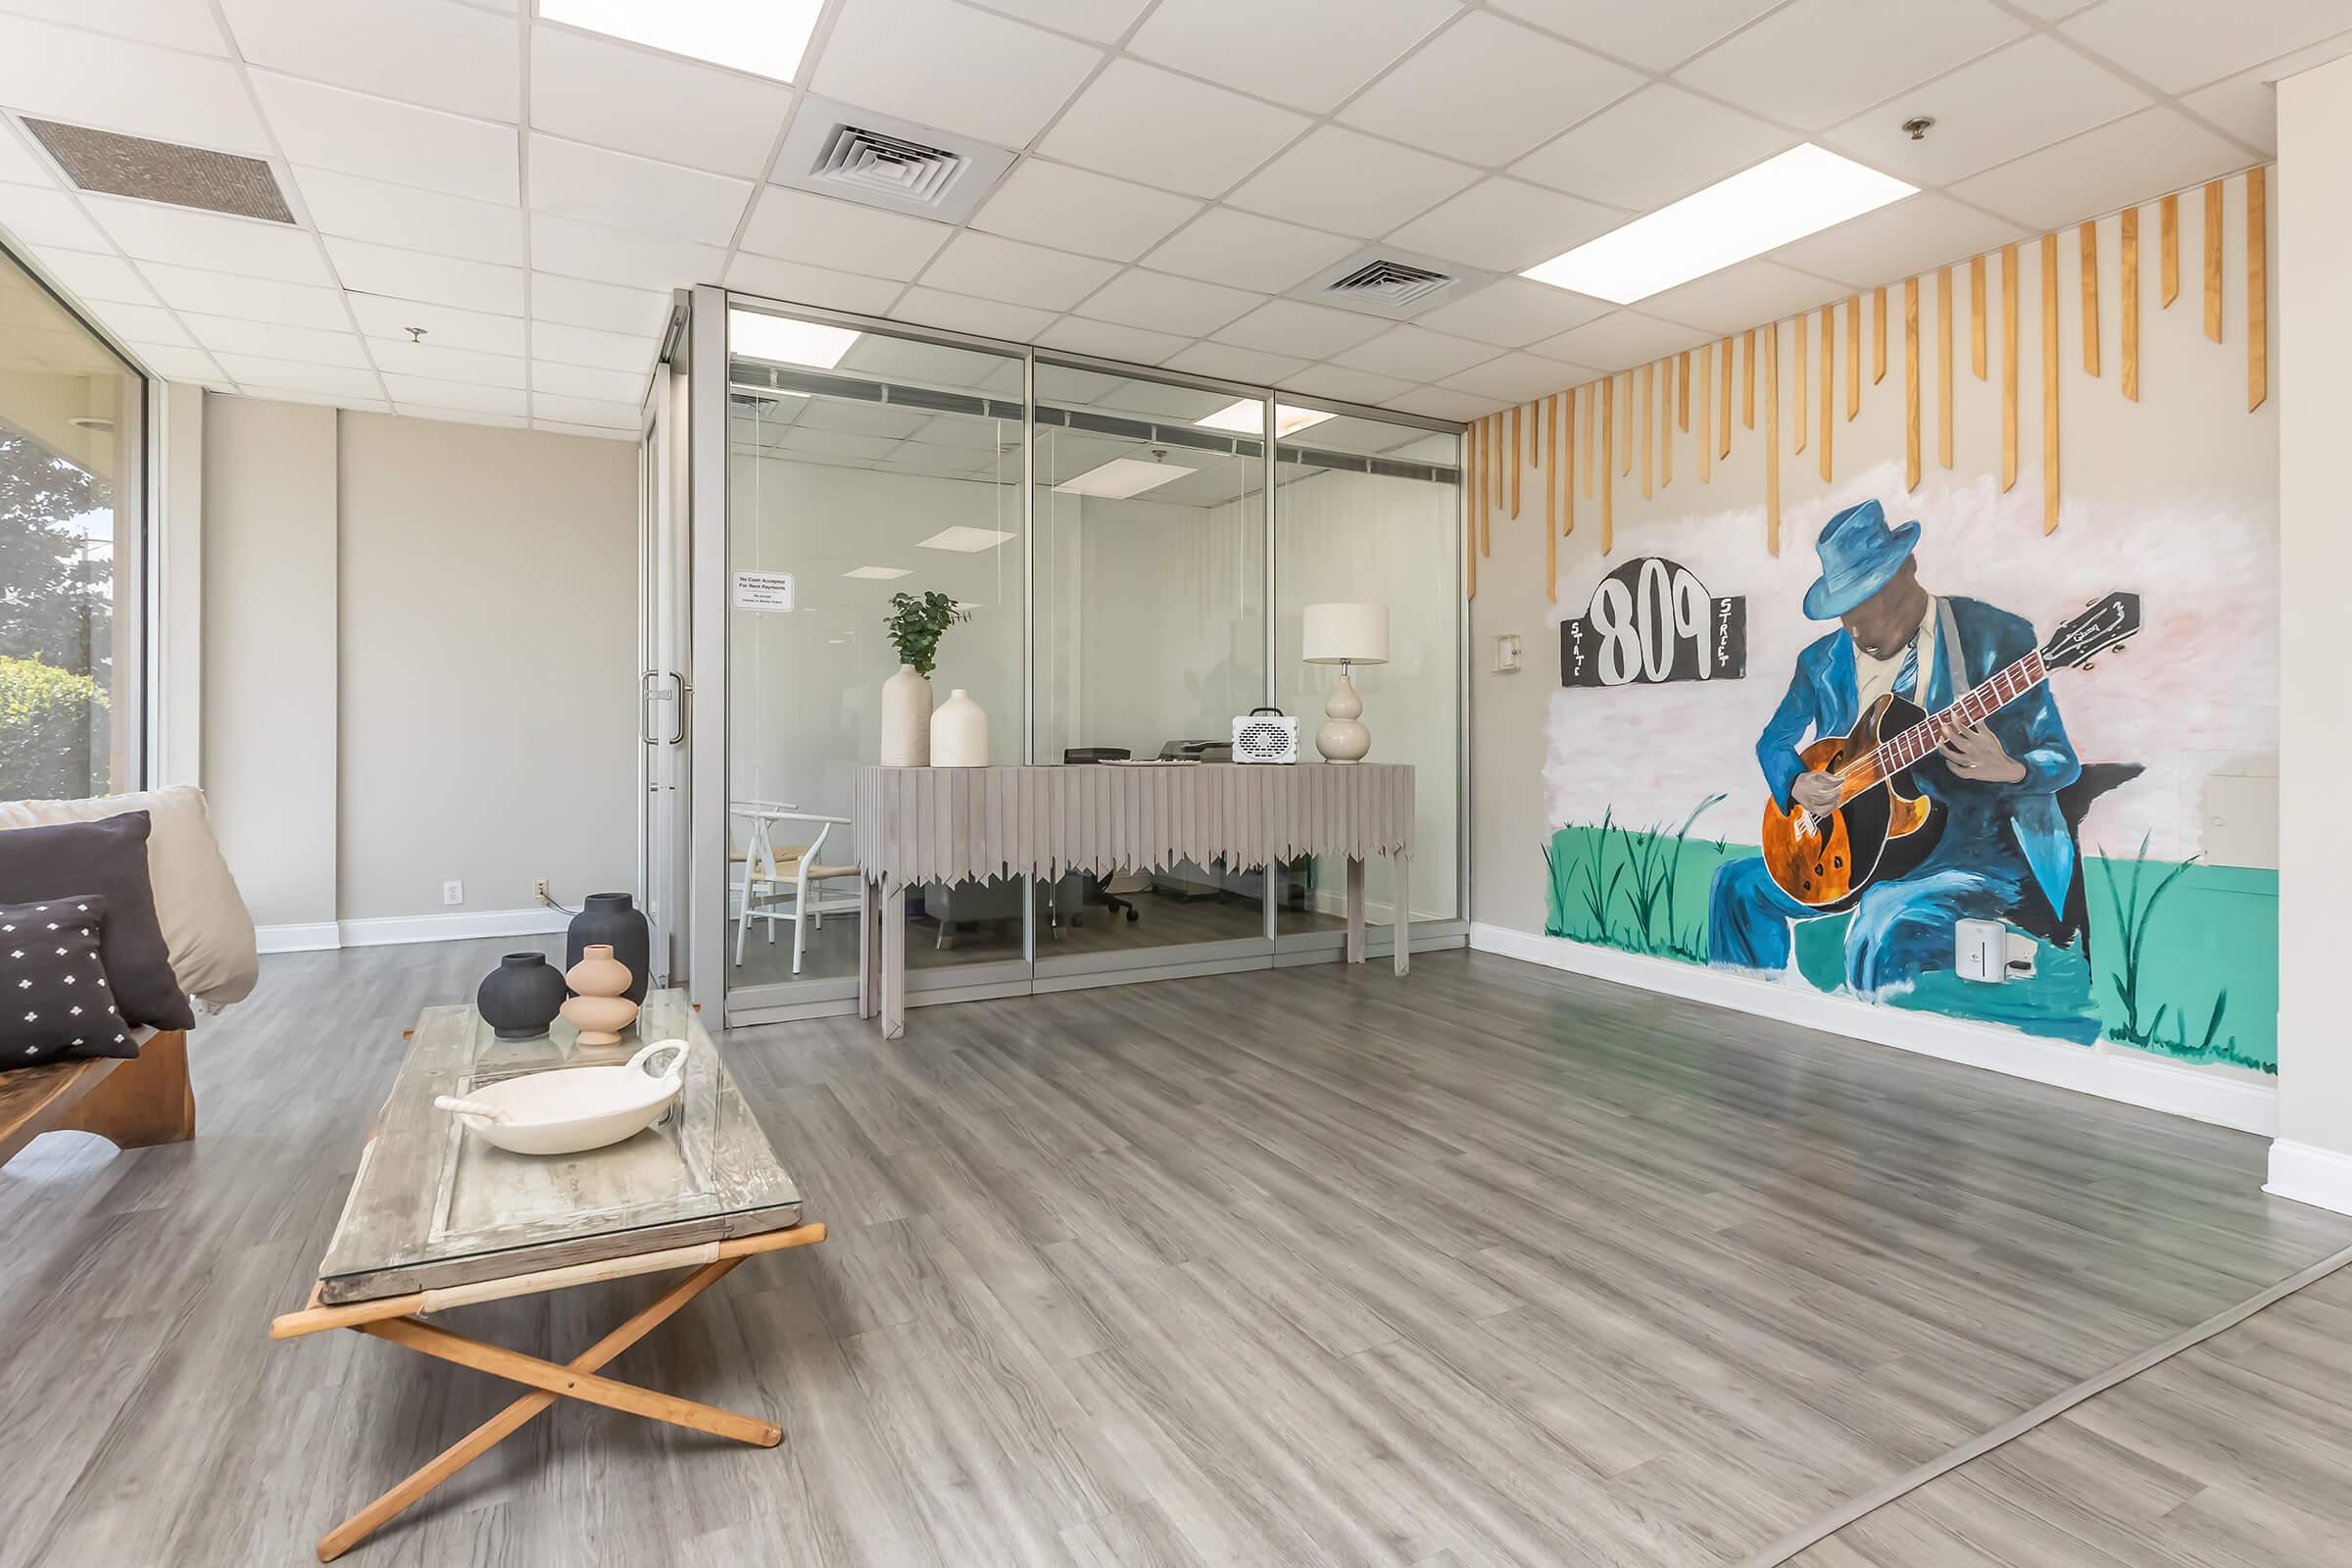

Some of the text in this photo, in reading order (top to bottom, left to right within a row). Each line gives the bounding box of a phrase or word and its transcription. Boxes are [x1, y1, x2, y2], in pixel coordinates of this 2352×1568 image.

[1570, 621, 1585, 677] STATE
[1590, 559, 1711, 686] 809
[1717, 598, 1732, 667] STREET
